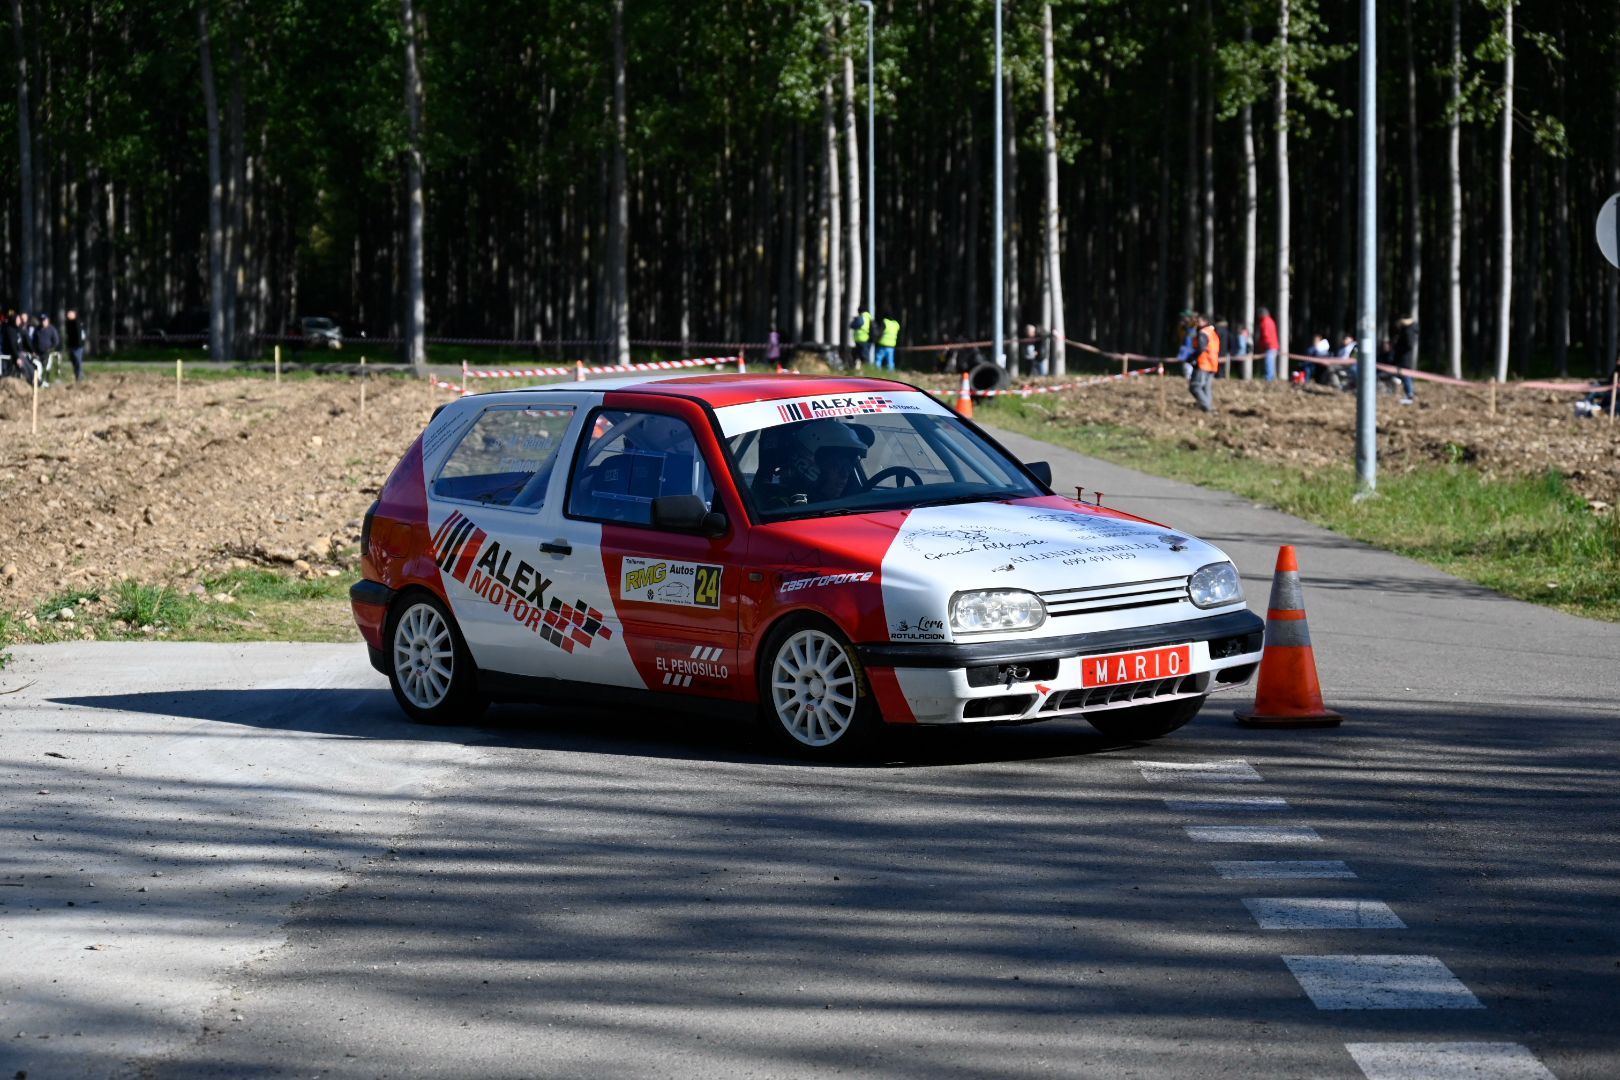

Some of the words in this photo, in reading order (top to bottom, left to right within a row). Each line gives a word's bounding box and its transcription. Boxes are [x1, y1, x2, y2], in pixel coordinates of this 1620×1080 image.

[811, 398, 857, 411] ALEX
[814, 407, 861, 418] MOTOR
[477, 541, 552, 611] ALEX
[625, 563, 667, 592] RMG
[670, 564, 694, 575] Autos
[695, 568, 718, 604] 24
[469, 569, 542, 633] MOTOR
[656, 656, 669, 671] EL
[671, 659, 728, 679] PENOSILLO
[1096, 651, 1180, 684] MARIO
